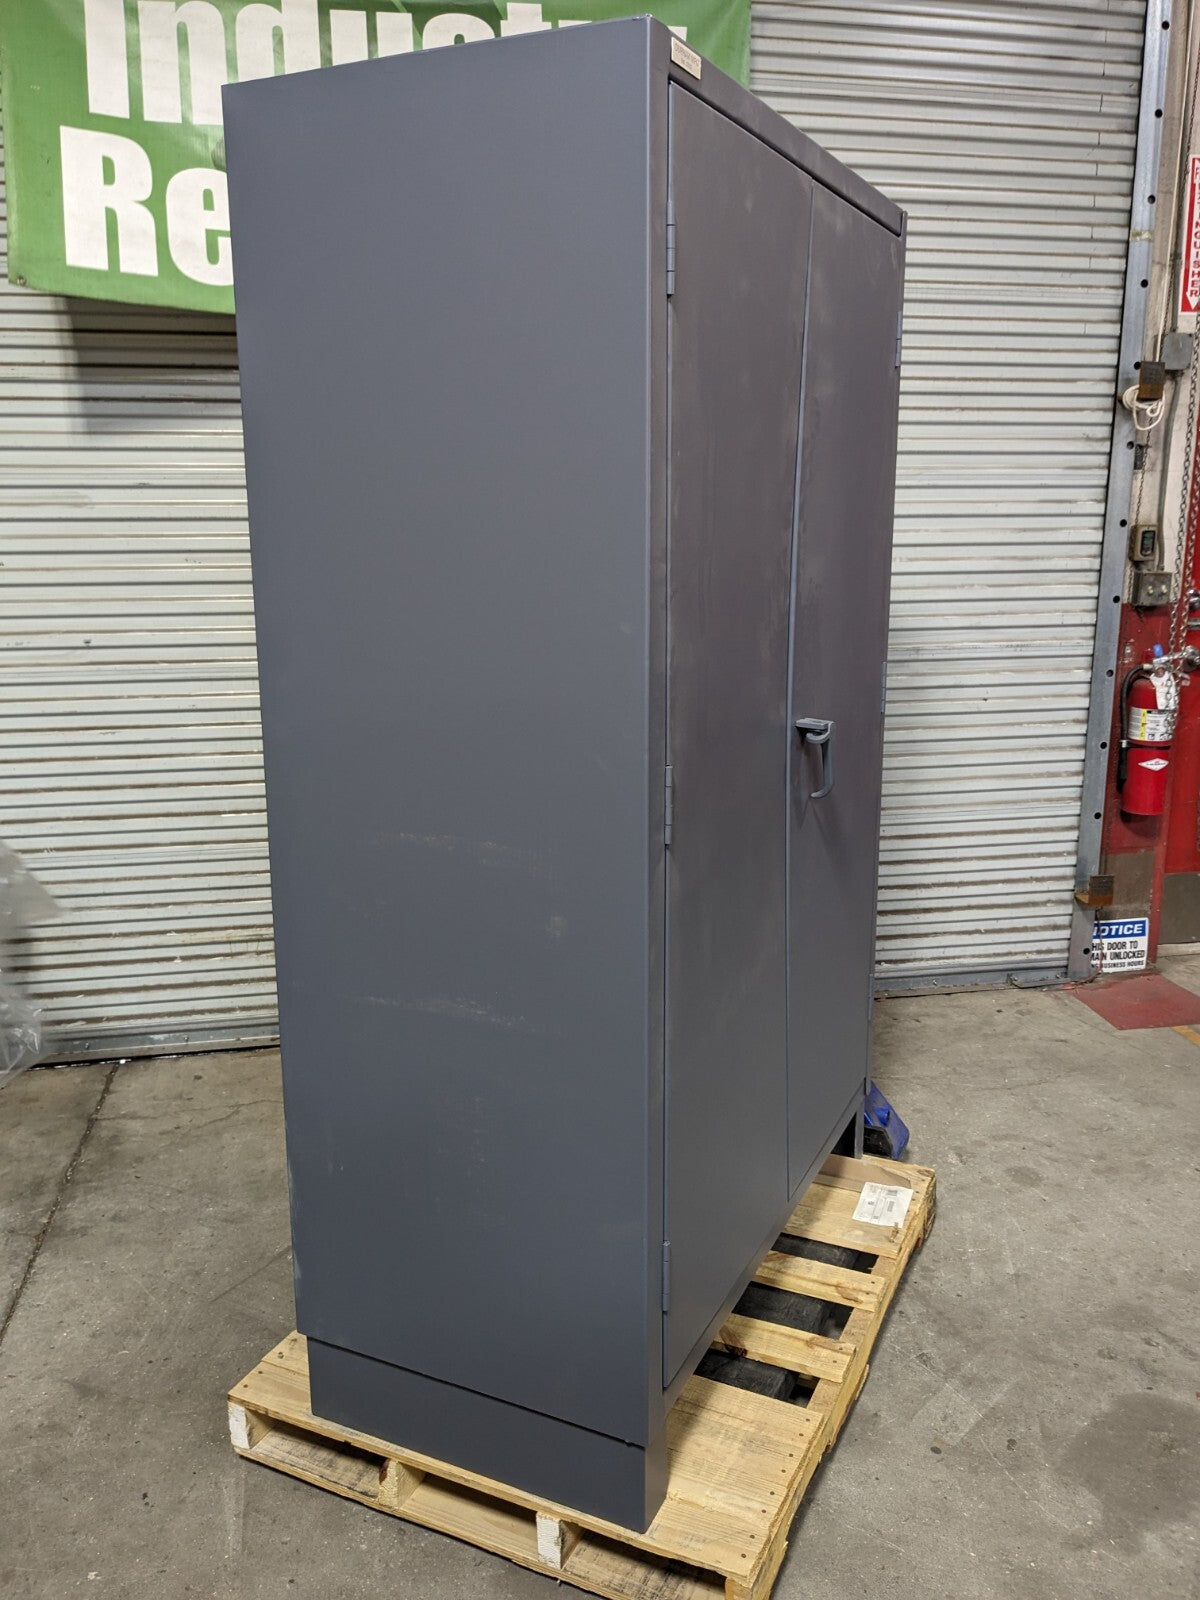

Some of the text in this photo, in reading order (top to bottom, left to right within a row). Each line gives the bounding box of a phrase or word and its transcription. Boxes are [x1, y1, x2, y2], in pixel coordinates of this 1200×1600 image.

[1091, 941, 1138, 951] HIS DOOR TO
[1110, 950, 1145, 960] UNLOCKED
